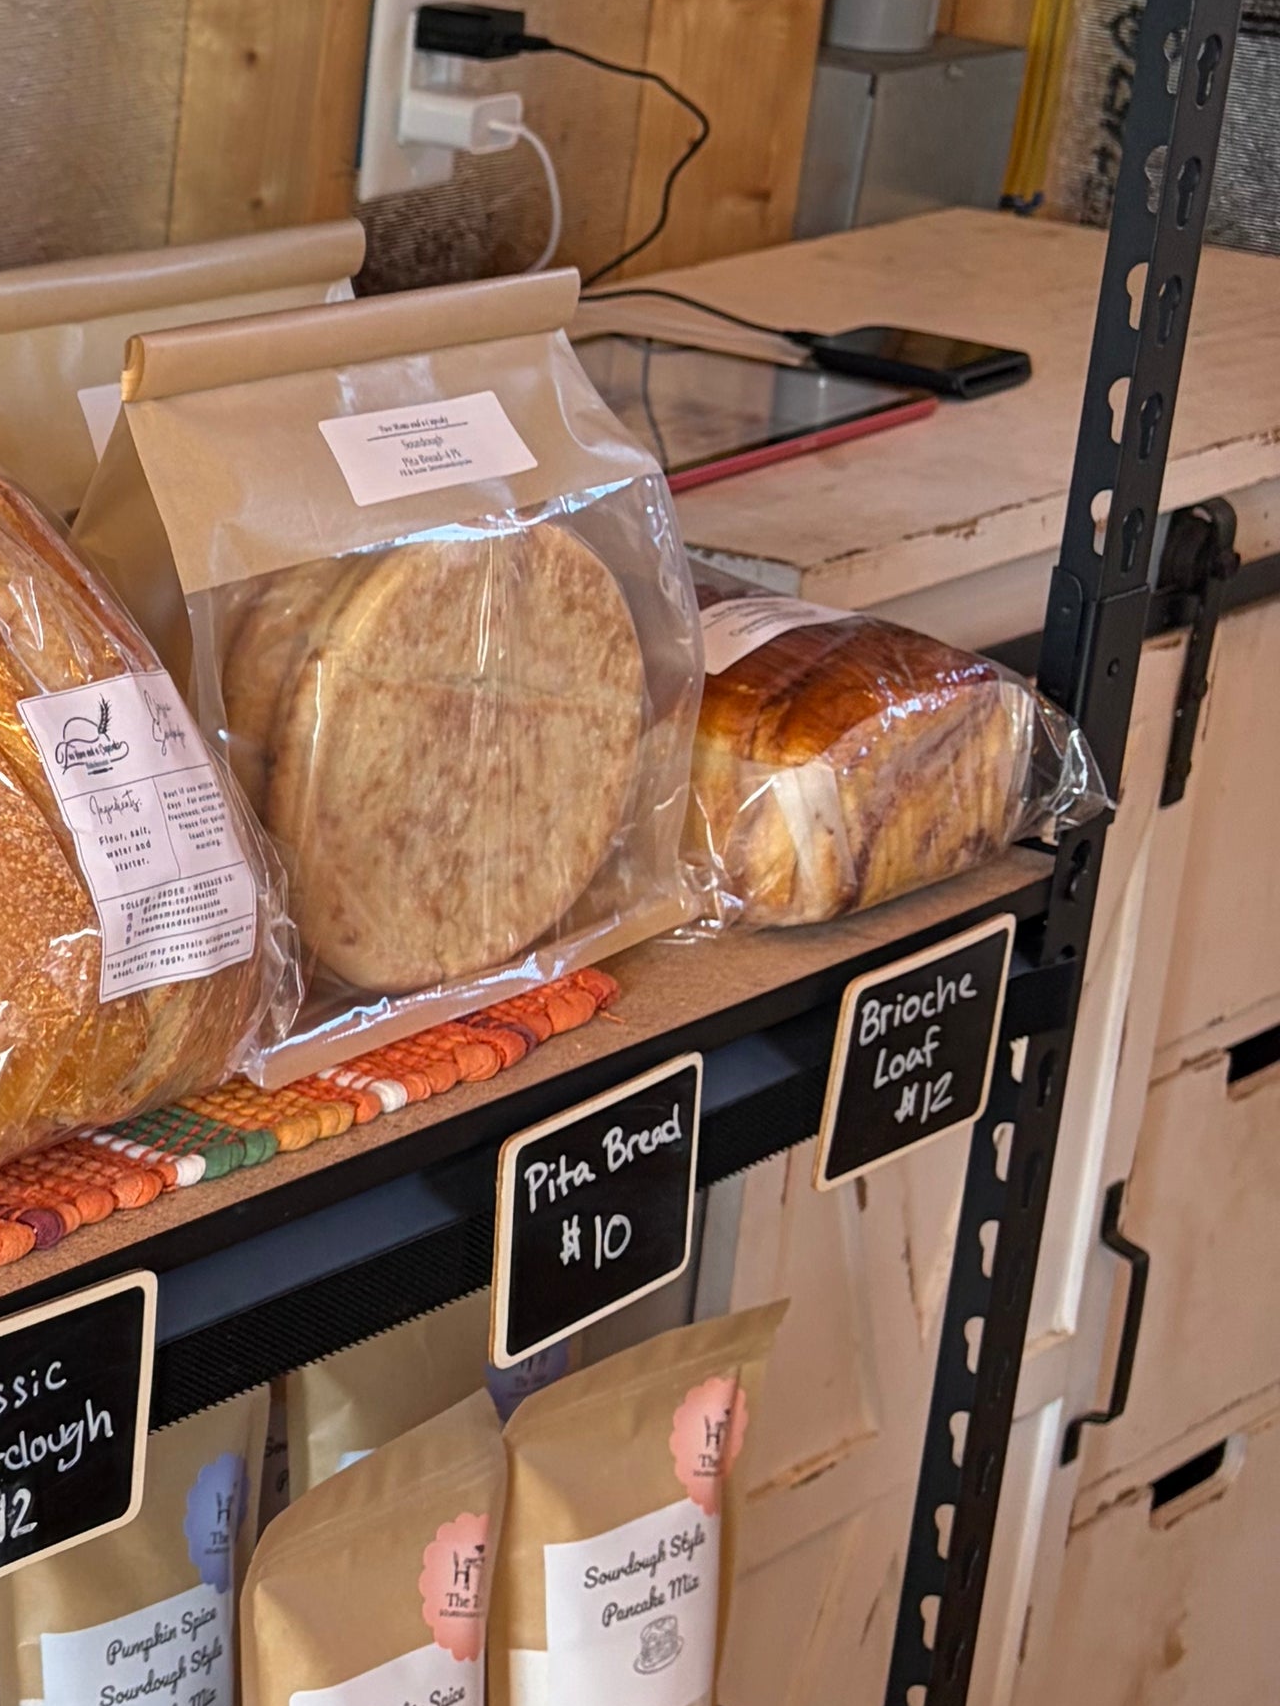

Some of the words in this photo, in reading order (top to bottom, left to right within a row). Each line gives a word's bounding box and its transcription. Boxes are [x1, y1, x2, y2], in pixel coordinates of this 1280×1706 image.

[858, 972, 978, 1046] Brioche
[873, 1025, 942, 1090] Loaf
[893, 1070, 954, 1124] $12
[523, 1154, 596, 1214] Pita
[601, 1102, 682, 1173] Bread
[558, 1213, 633, 1271] $10
[583, 1539, 667, 1590] Sourdough
[669, 1523, 707, 1561] Style
[602, 1585, 665, 1628] Pancake
[667, 1573, 701, 1601] Mix
[105, 1621, 178, 1666] Pumpkin
[180, 1606, 218, 1642] Spice
[189, 1635, 224, 1676] Style
